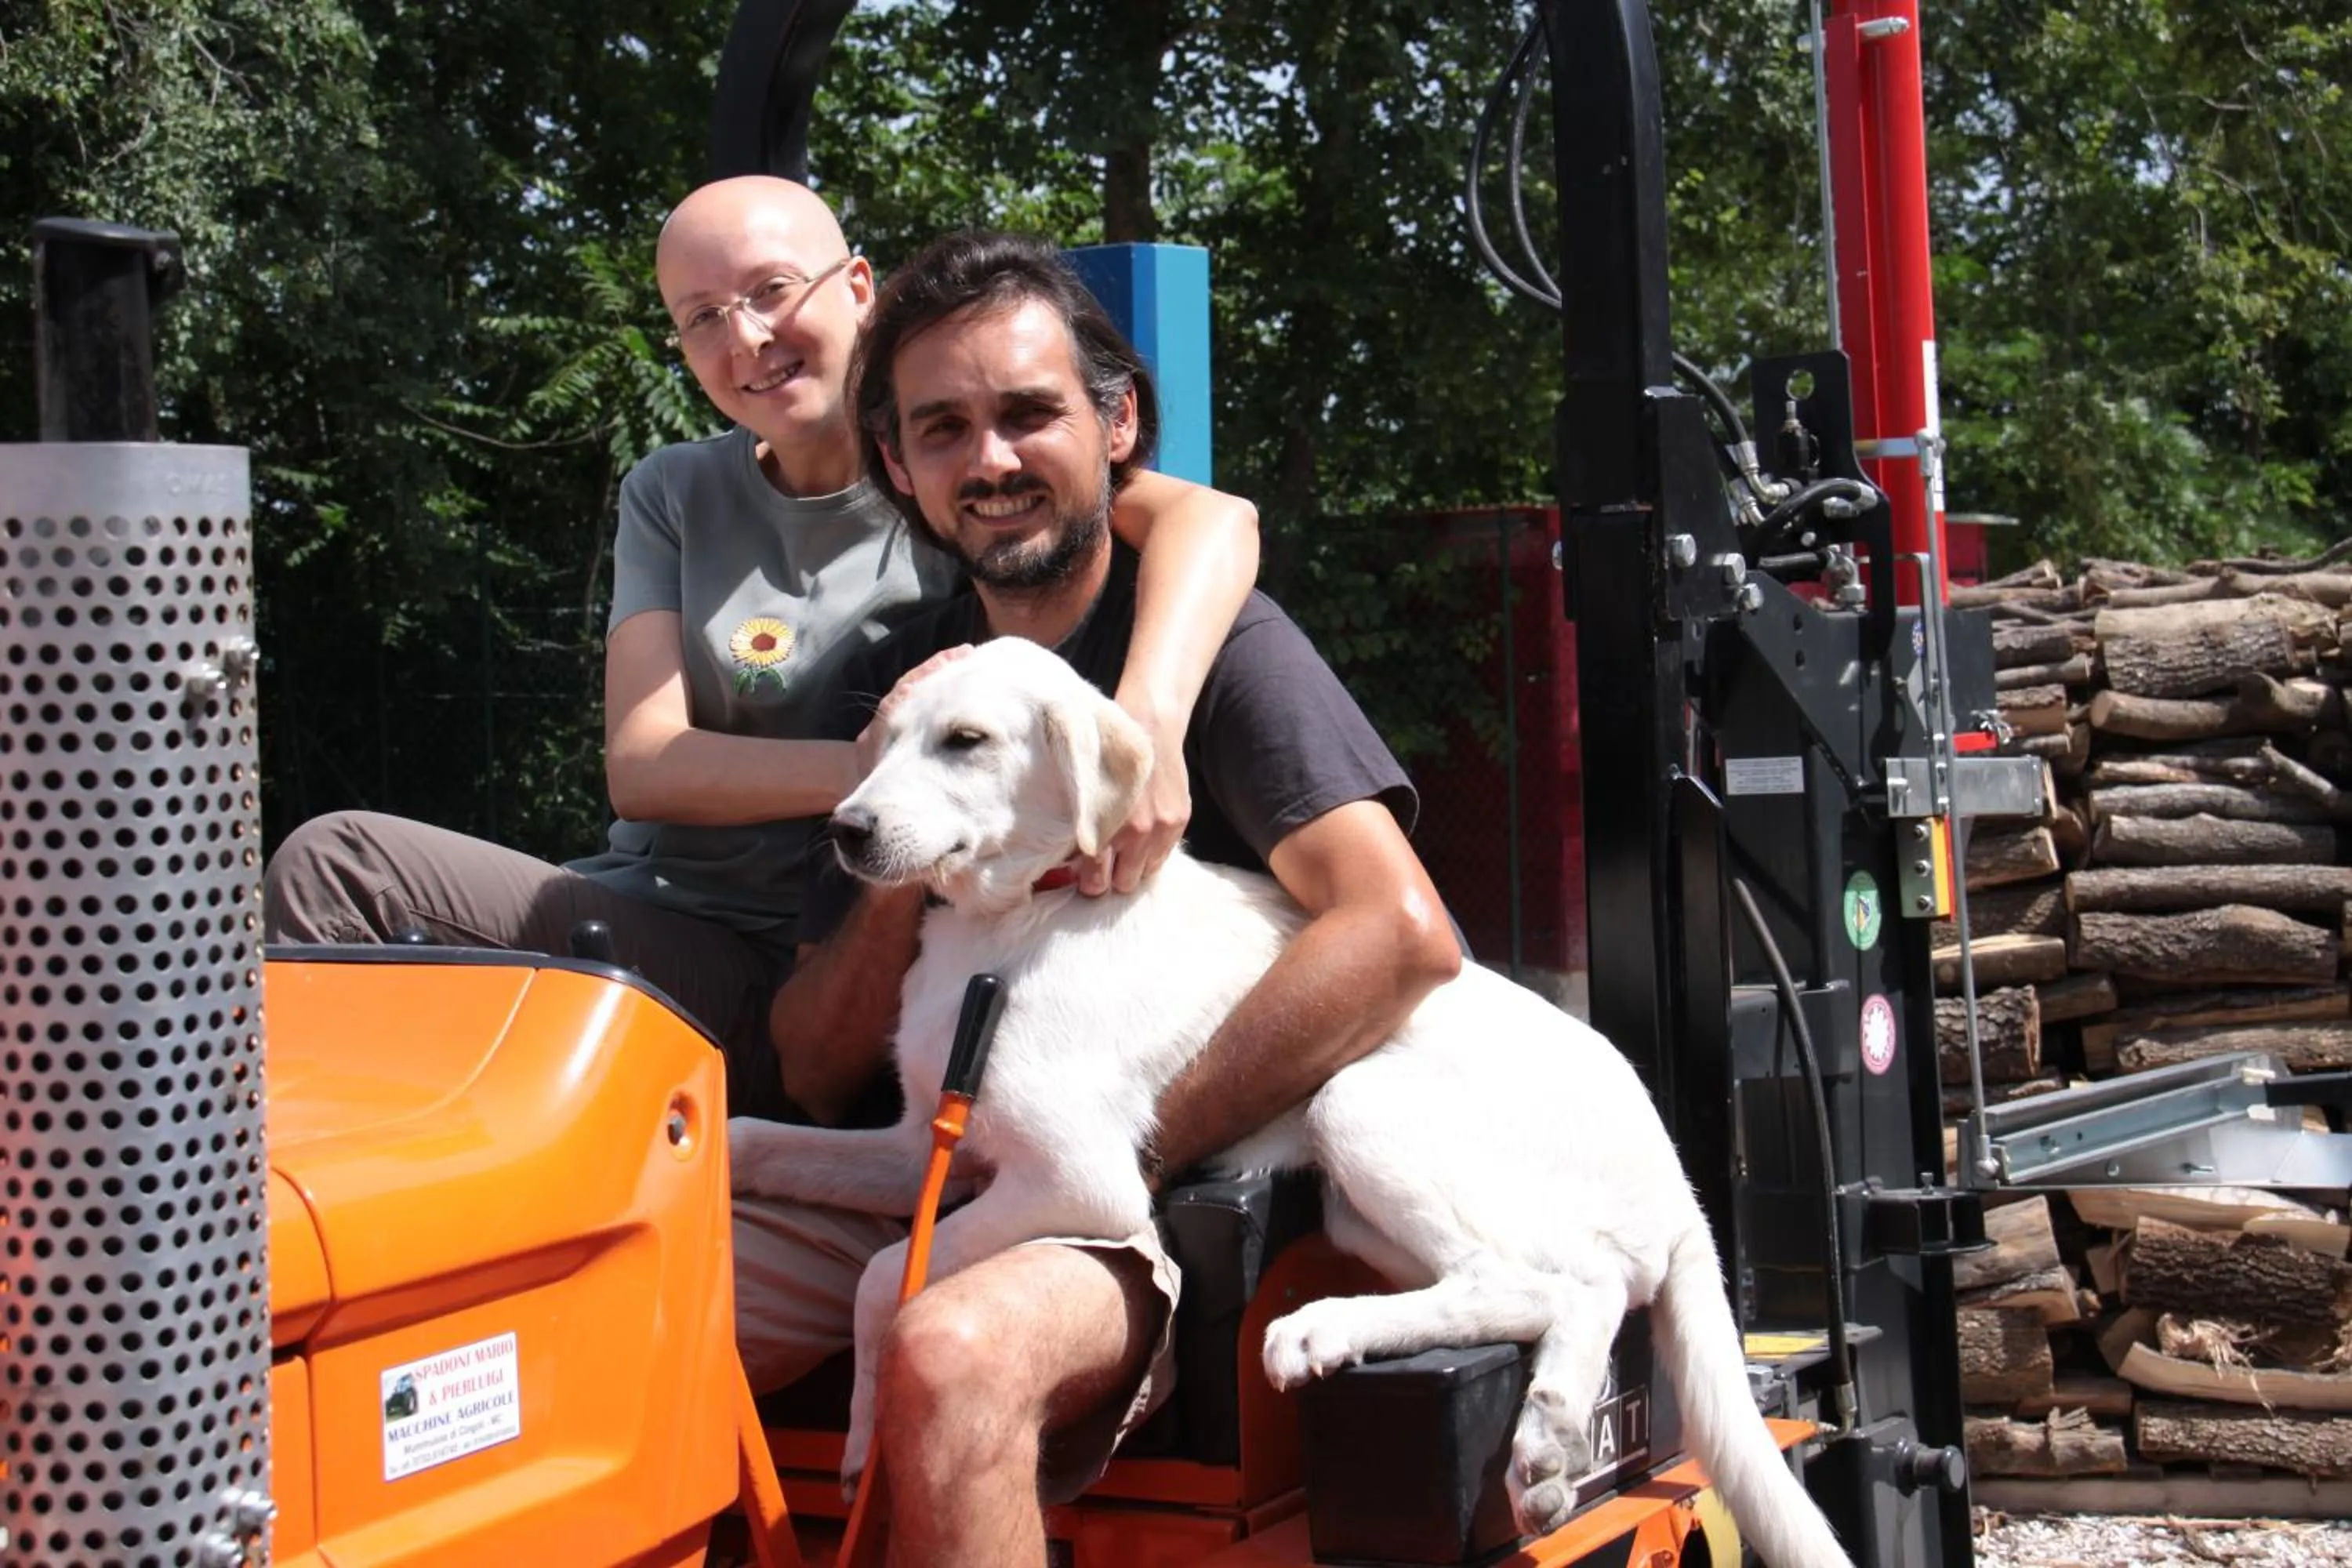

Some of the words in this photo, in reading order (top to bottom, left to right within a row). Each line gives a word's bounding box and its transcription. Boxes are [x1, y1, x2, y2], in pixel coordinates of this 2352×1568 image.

[414, 1352, 470, 1384] SPADONI
[474, 1339, 514, 1364] MARIO
[441, 1368, 504, 1401] PIERLUIGI
[387, 1411, 451, 1443] MACCHINE
[457, 1390, 514, 1420] AGRICOLE
[1597, 1399, 1642, 1459] AT
